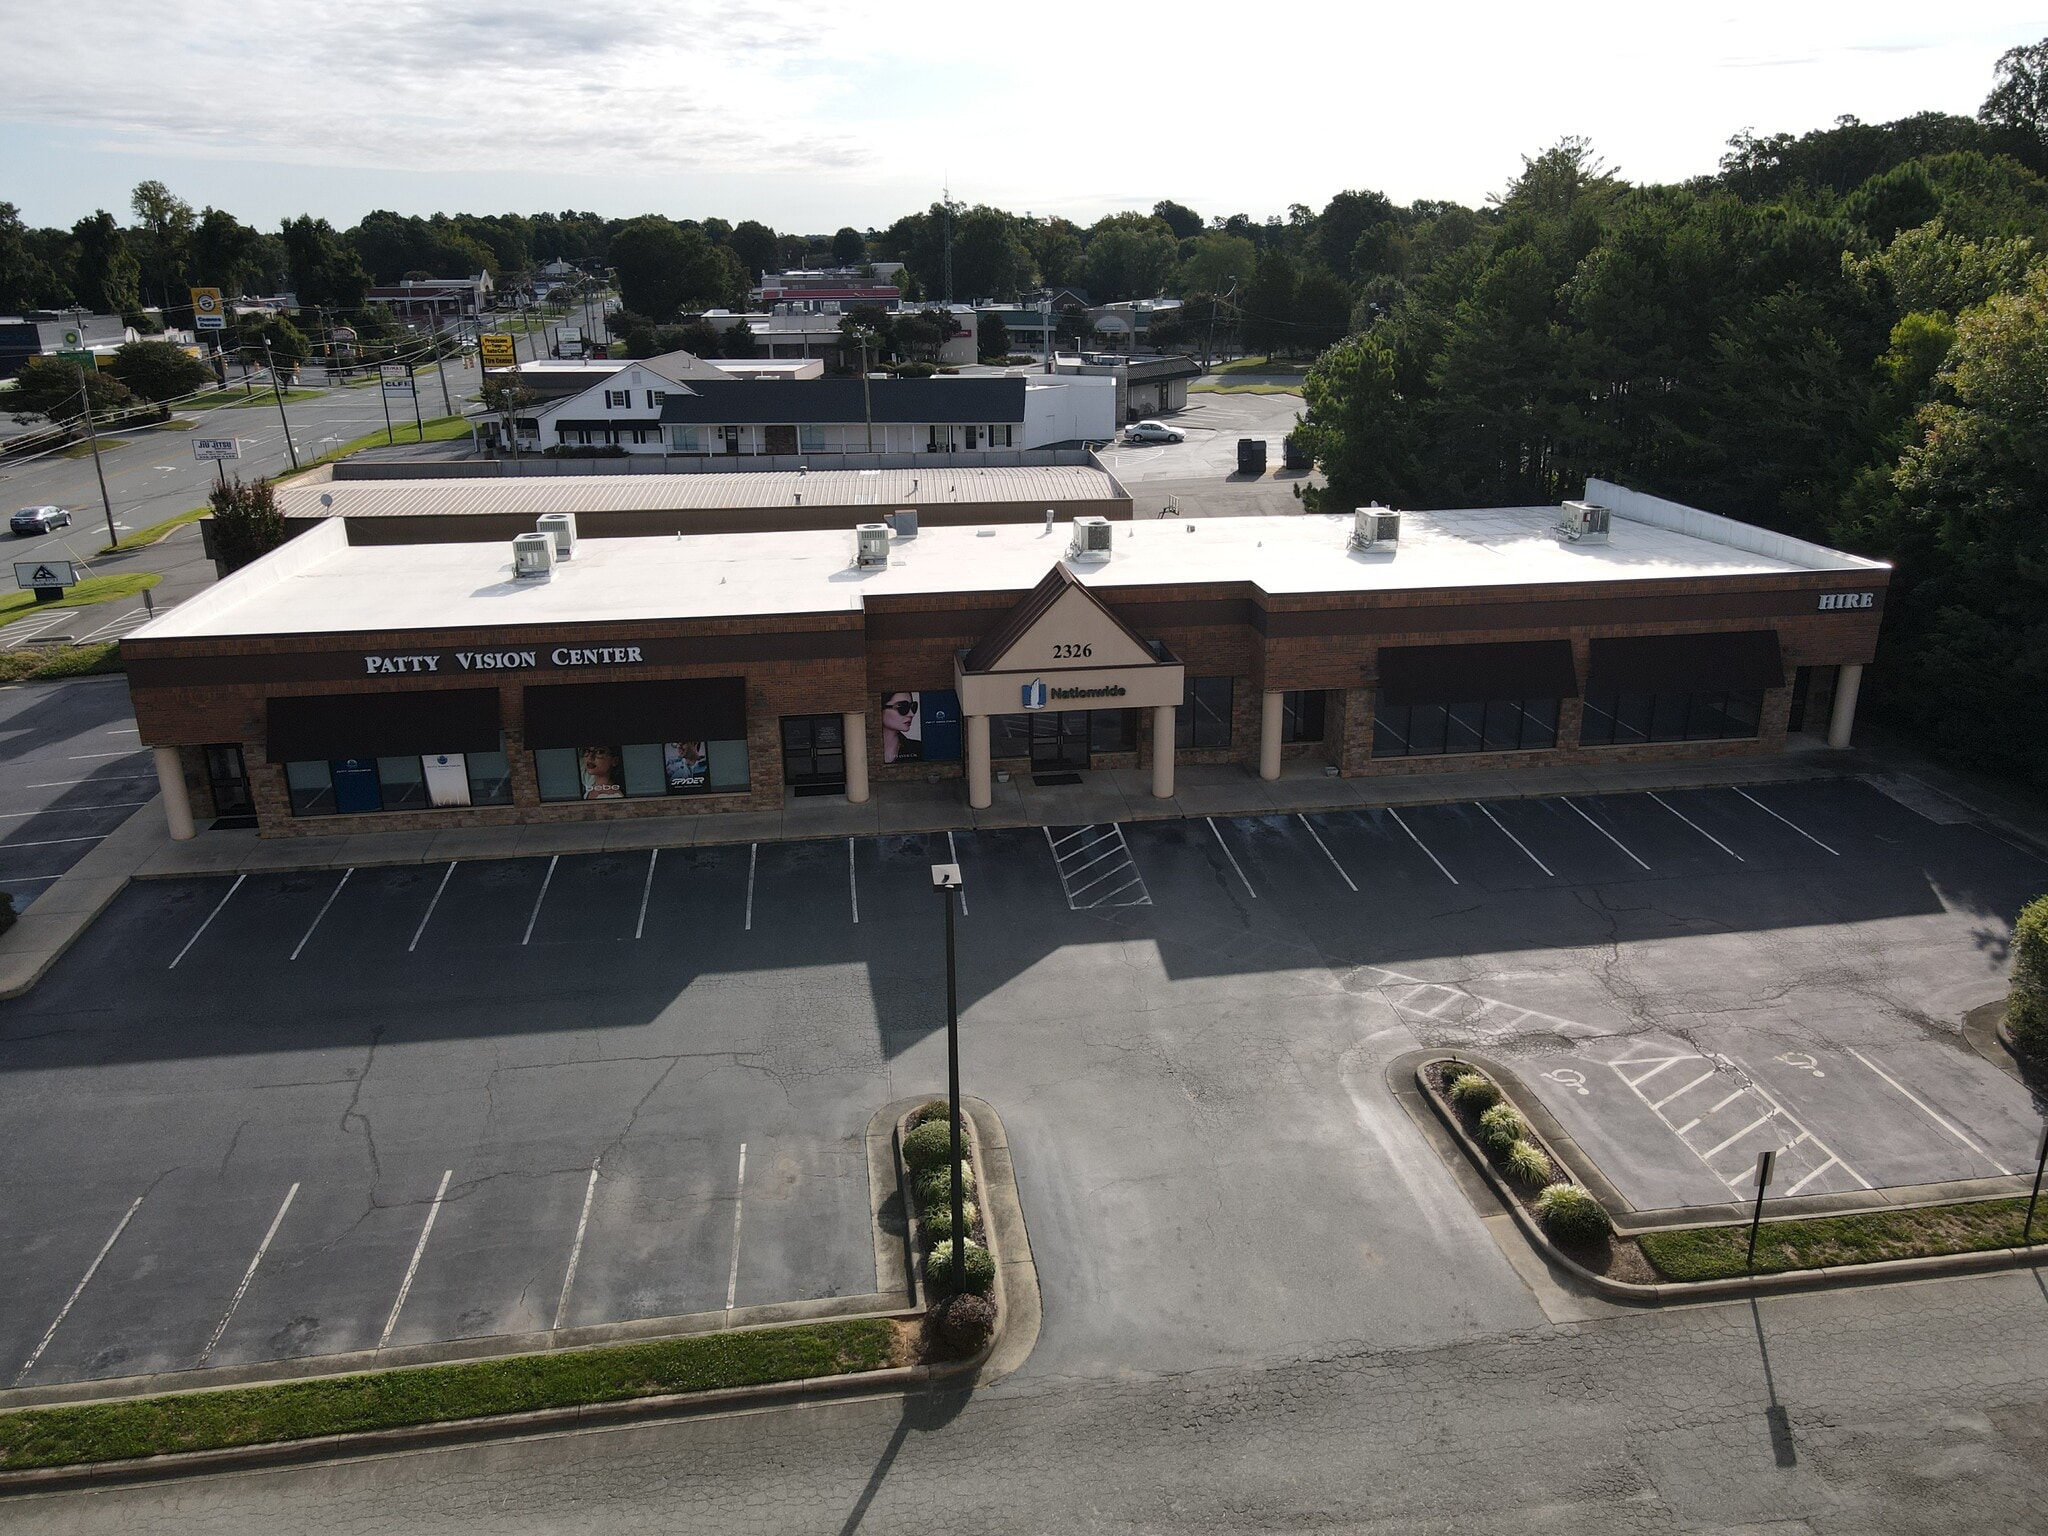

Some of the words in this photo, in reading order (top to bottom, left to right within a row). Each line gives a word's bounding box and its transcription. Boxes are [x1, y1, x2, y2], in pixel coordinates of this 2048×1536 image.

[1817, 592, 1874, 610] HIRE
[1053, 643, 1093, 659] 2326
[364, 655, 440, 674] PATTY
[455, 651, 537, 670] VISION
[551, 646, 644, 666] CENTER
[1051, 685, 1126, 700] Nationwide
[584, 783, 620, 791] bebe
[670, 777, 705, 786] SPYDER
